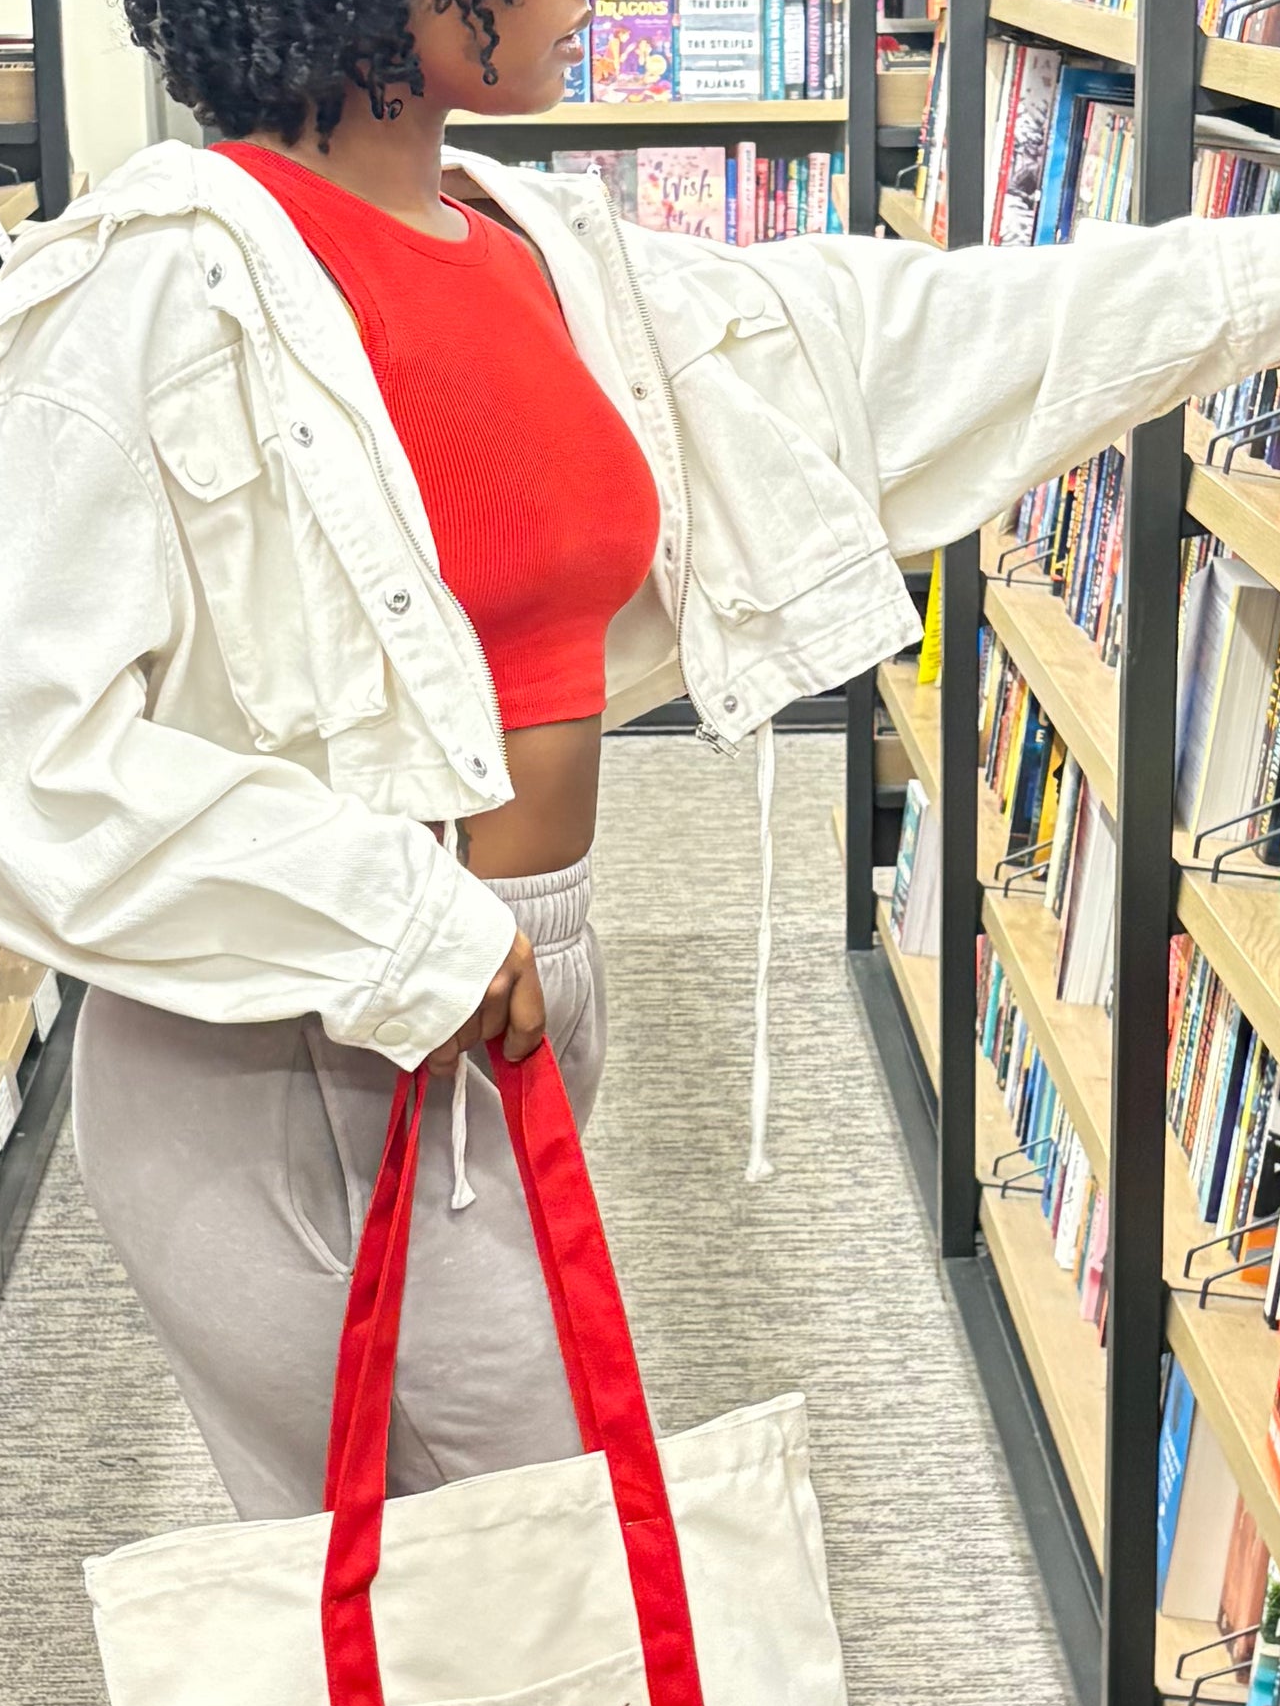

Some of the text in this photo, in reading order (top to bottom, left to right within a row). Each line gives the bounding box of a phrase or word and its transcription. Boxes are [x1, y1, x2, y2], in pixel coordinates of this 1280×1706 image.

[595, 0, 669, 19] DRAGONS
[688, 39, 754, 50] THE STRIPED
[695, 79, 746, 90] PAJAMAS
